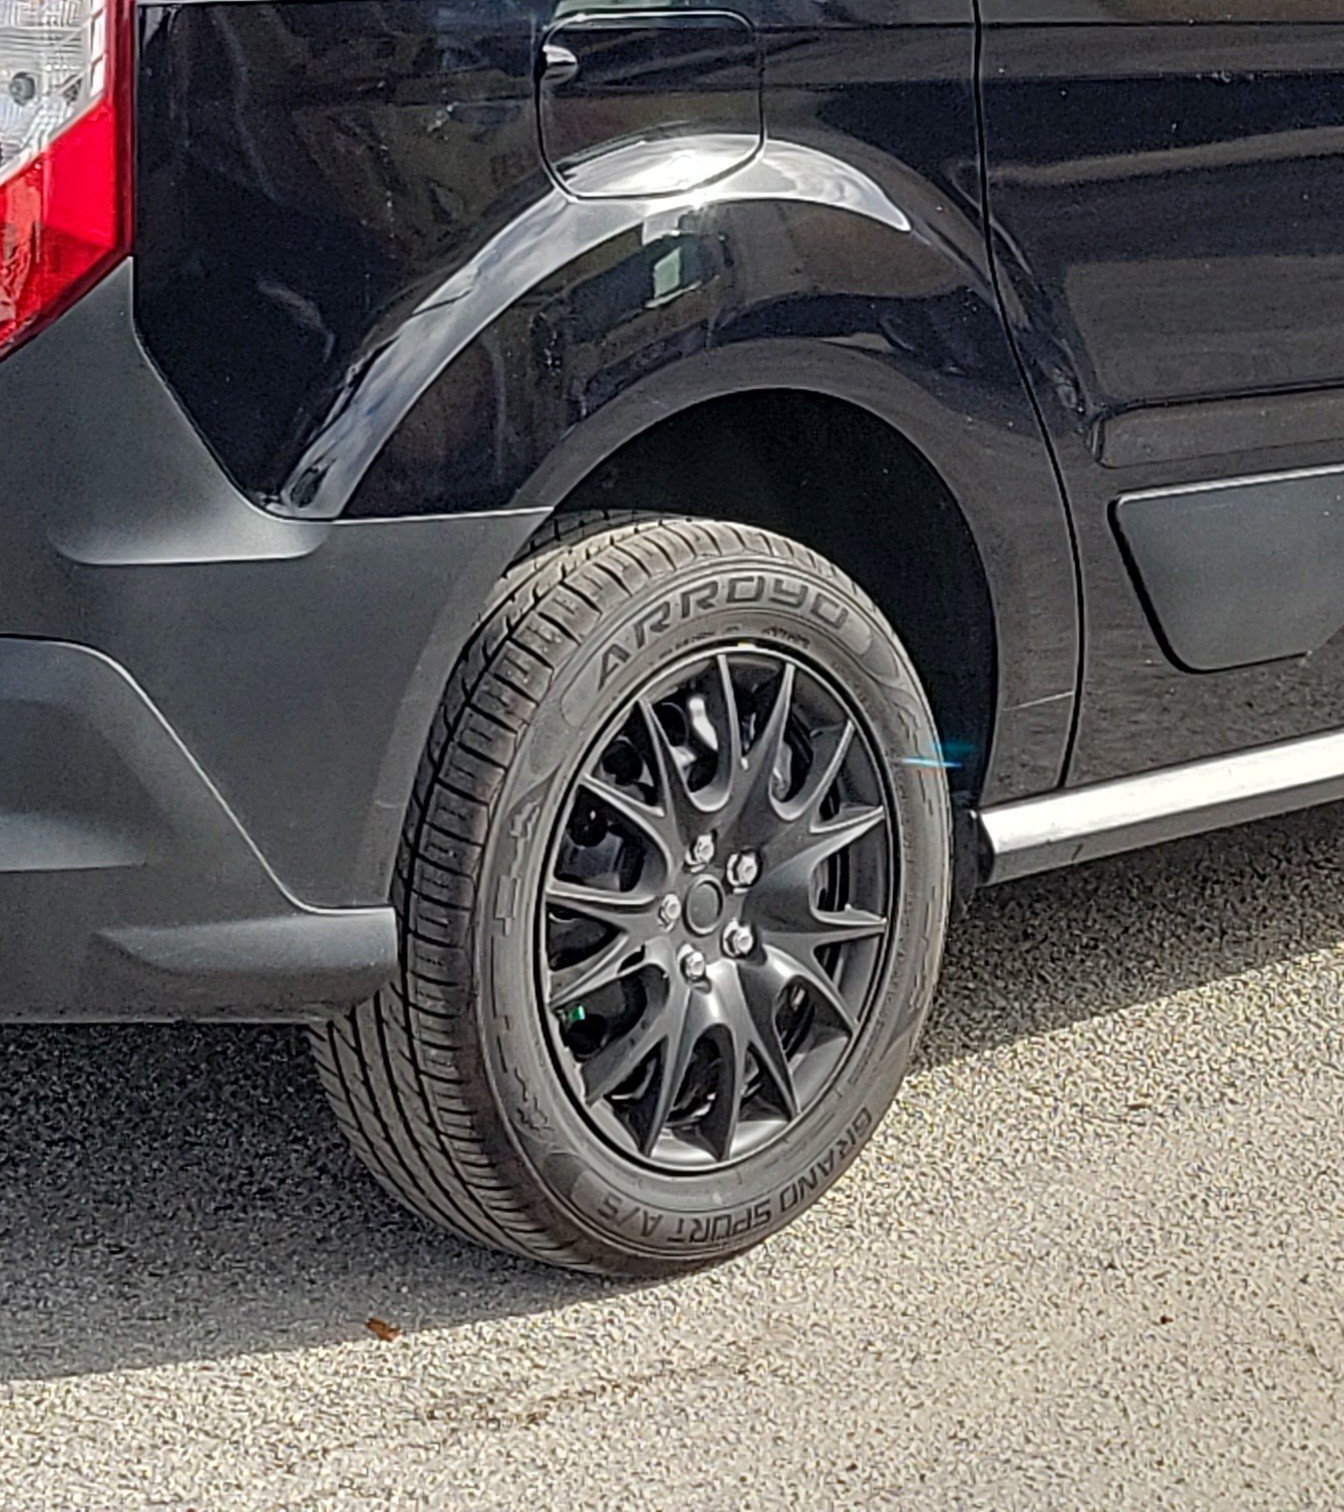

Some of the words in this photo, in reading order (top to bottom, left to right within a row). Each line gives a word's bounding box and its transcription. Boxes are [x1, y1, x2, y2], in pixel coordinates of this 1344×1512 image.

[597, 574, 850, 692] ARROYO
[779, 1105, 873, 1213] GRAND
[666, 1197, 772, 1243] SPORT
